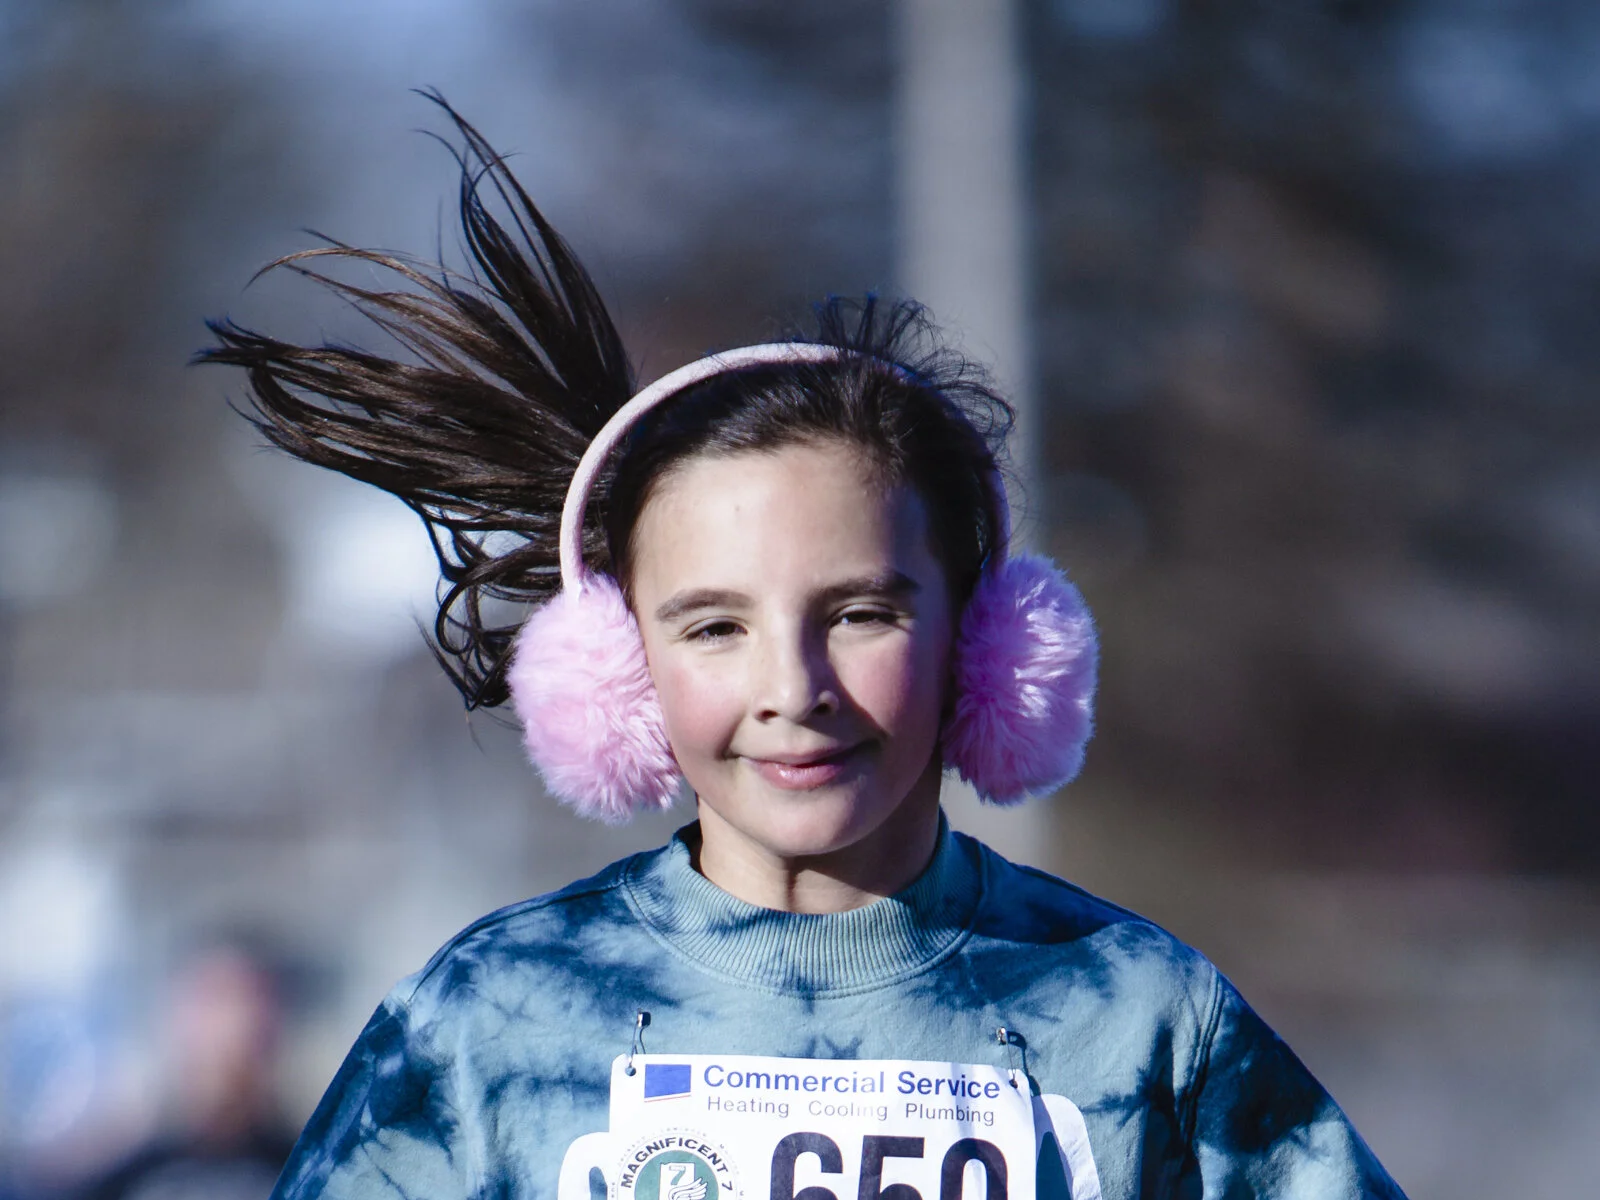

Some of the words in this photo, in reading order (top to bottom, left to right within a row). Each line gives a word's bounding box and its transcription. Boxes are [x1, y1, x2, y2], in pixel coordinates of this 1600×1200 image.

[703, 1064, 885, 1093] Commercial
[897, 1071, 1001, 1099] Service
[707, 1096, 790, 1118] Heating
[808, 1100, 889, 1121] Cooling
[905, 1103, 995, 1127] Plumbing
[620, 1136, 729, 1189] MAGNIFICENT
[721, 1180, 734, 1192] 7
